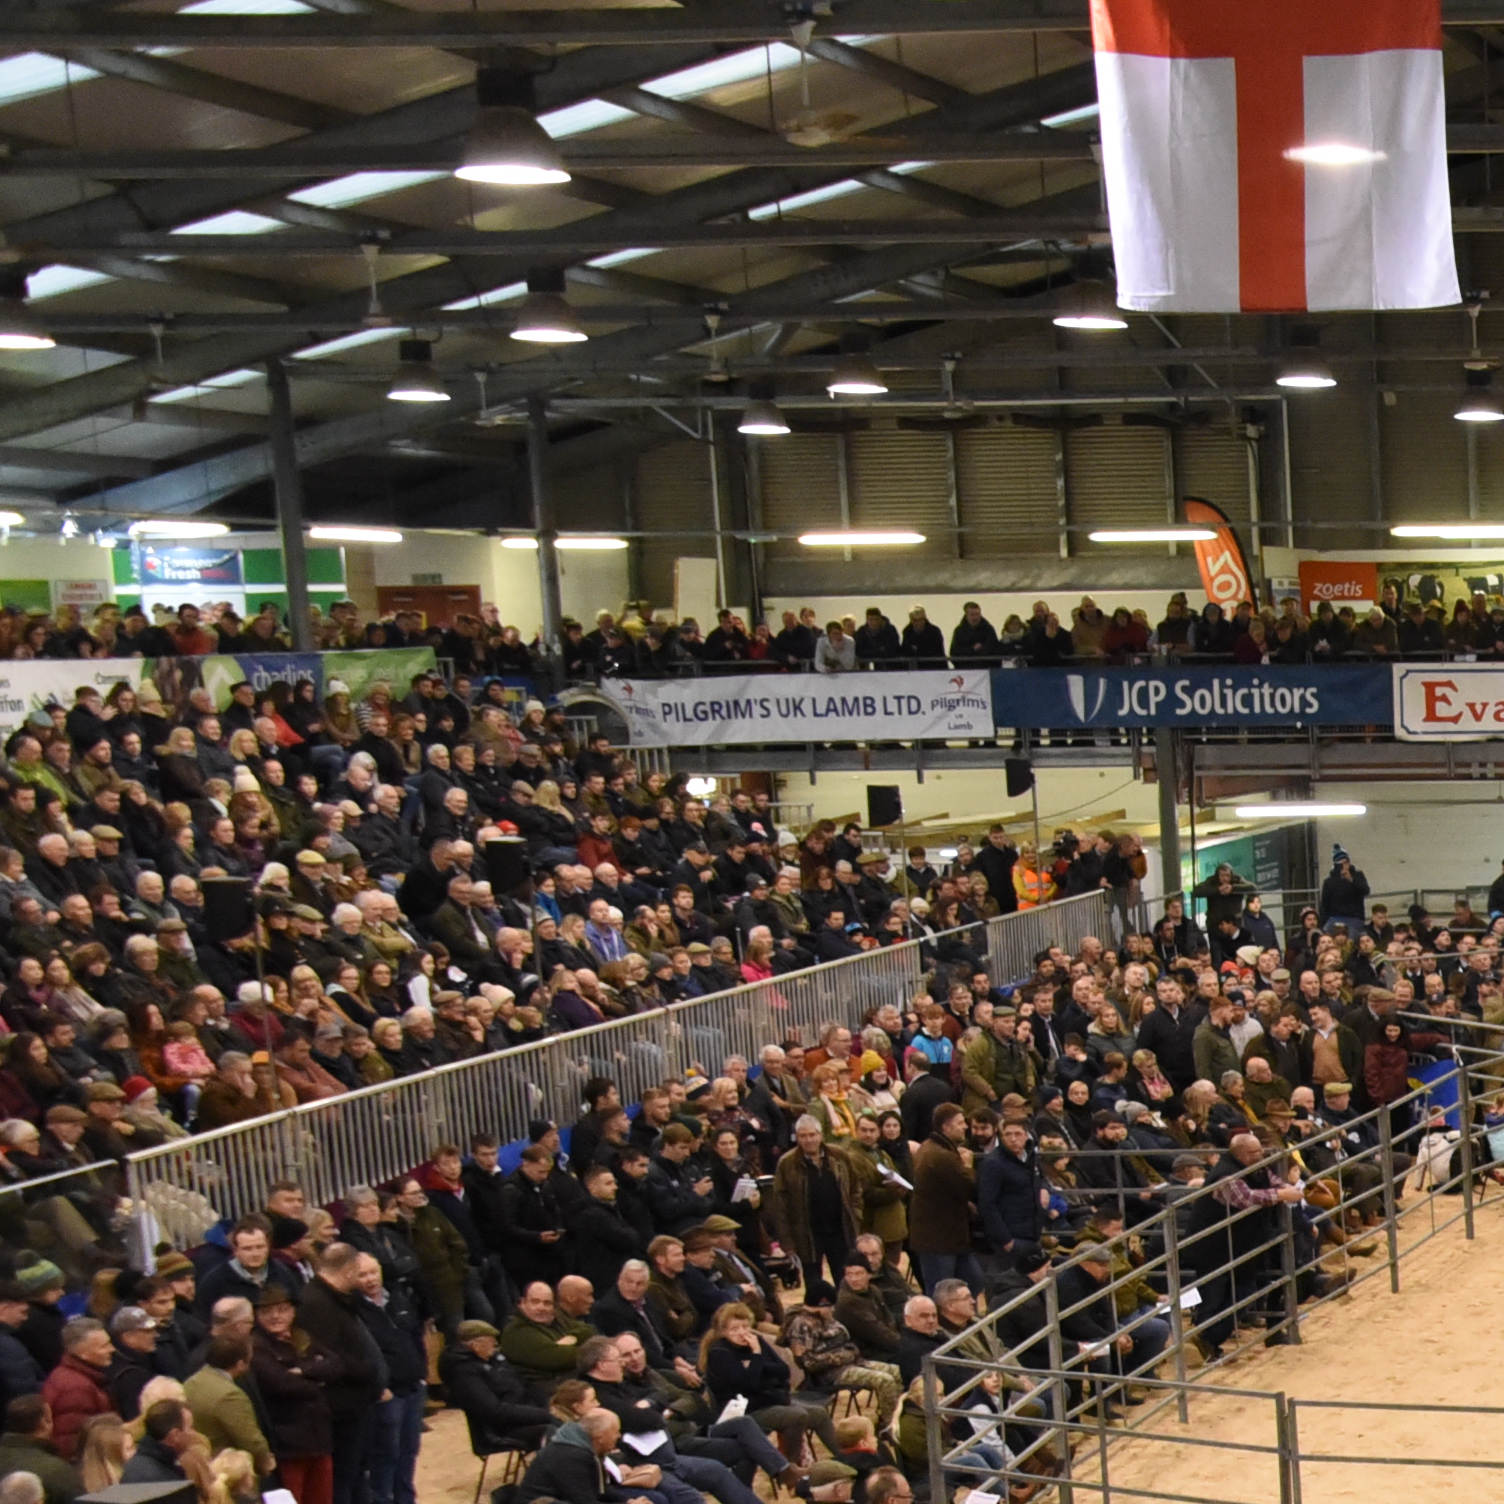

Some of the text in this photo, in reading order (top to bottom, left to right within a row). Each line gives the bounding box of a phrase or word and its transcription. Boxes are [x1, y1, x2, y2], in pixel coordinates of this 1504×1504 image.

[1313, 581, 1363, 599] zoetis
[931, 696, 988, 712] Pilgrim's
[1117, 678, 1319, 716] JCP Solicitors
[661, 694, 926, 723] PILGRIM'S UK LAMB LTD.
[947, 721, 973, 731] Lamb
